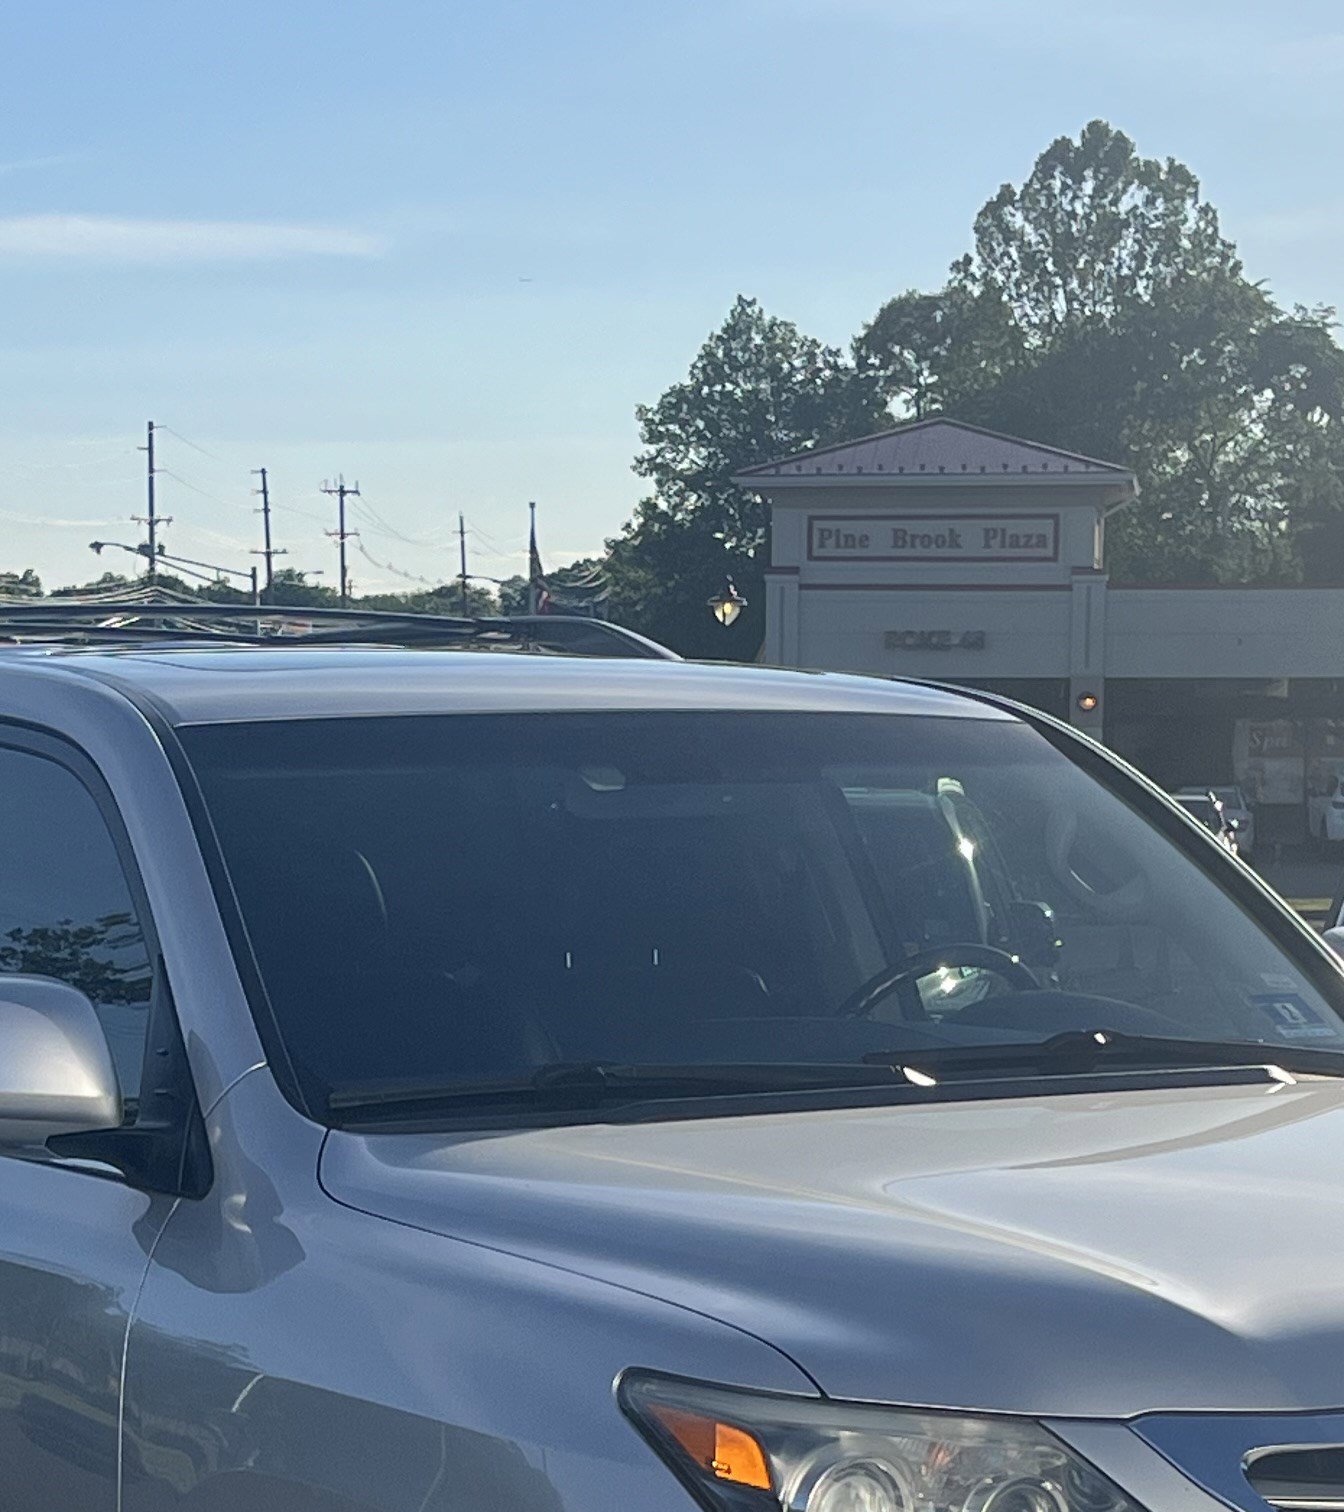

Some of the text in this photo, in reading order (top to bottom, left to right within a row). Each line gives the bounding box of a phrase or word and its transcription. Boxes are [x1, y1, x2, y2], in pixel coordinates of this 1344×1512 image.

[817, 527, 1048, 549] Pine Brook Plaza
